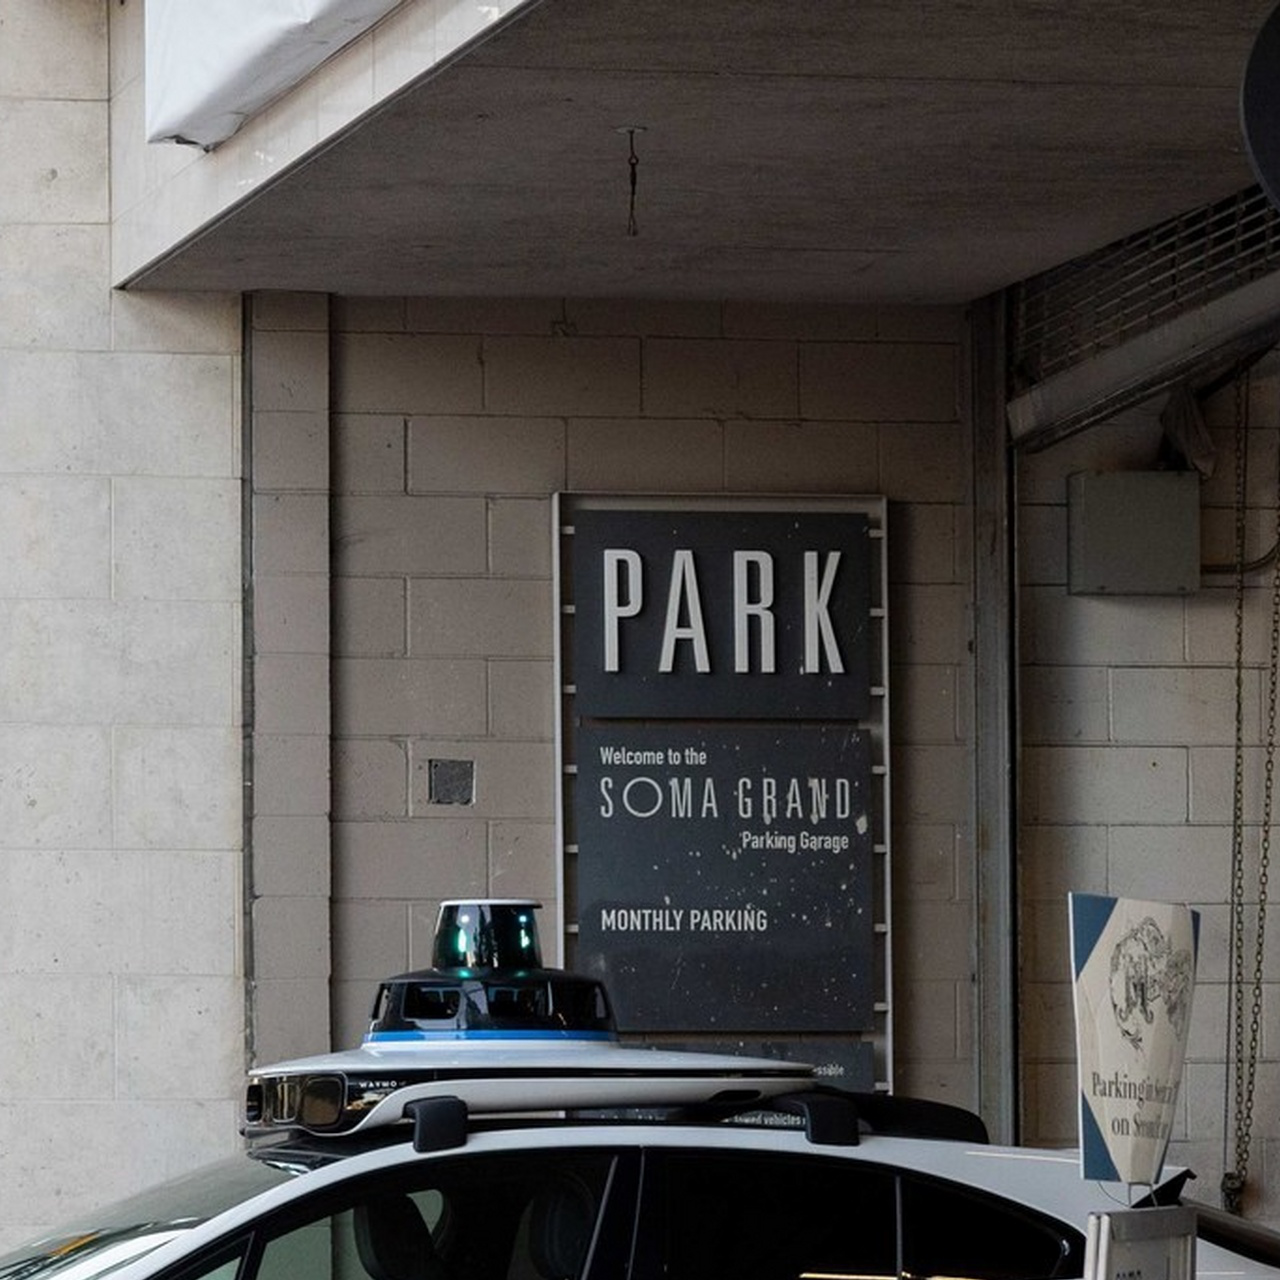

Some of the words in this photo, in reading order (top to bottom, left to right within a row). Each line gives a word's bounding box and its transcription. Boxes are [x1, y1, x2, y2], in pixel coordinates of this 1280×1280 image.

[603, 548, 846, 673] PARK
[600, 747, 664, 765] Welcome
[667, 748, 681, 765] to
[685, 747, 707, 765] the
[600, 777, 718, 818] SOMA
[738, 777, 850, 819] GRAND
[742, 831, 796, 853] Parking
[799, 832, 849, 853] Garage
[601, 909, 684, 931] MONTHLY
[690, 909, 768, 931] PARKING
[1092, 1071, 1145, 1110] Parking
[1111, 1116, 1131, 1137] on
